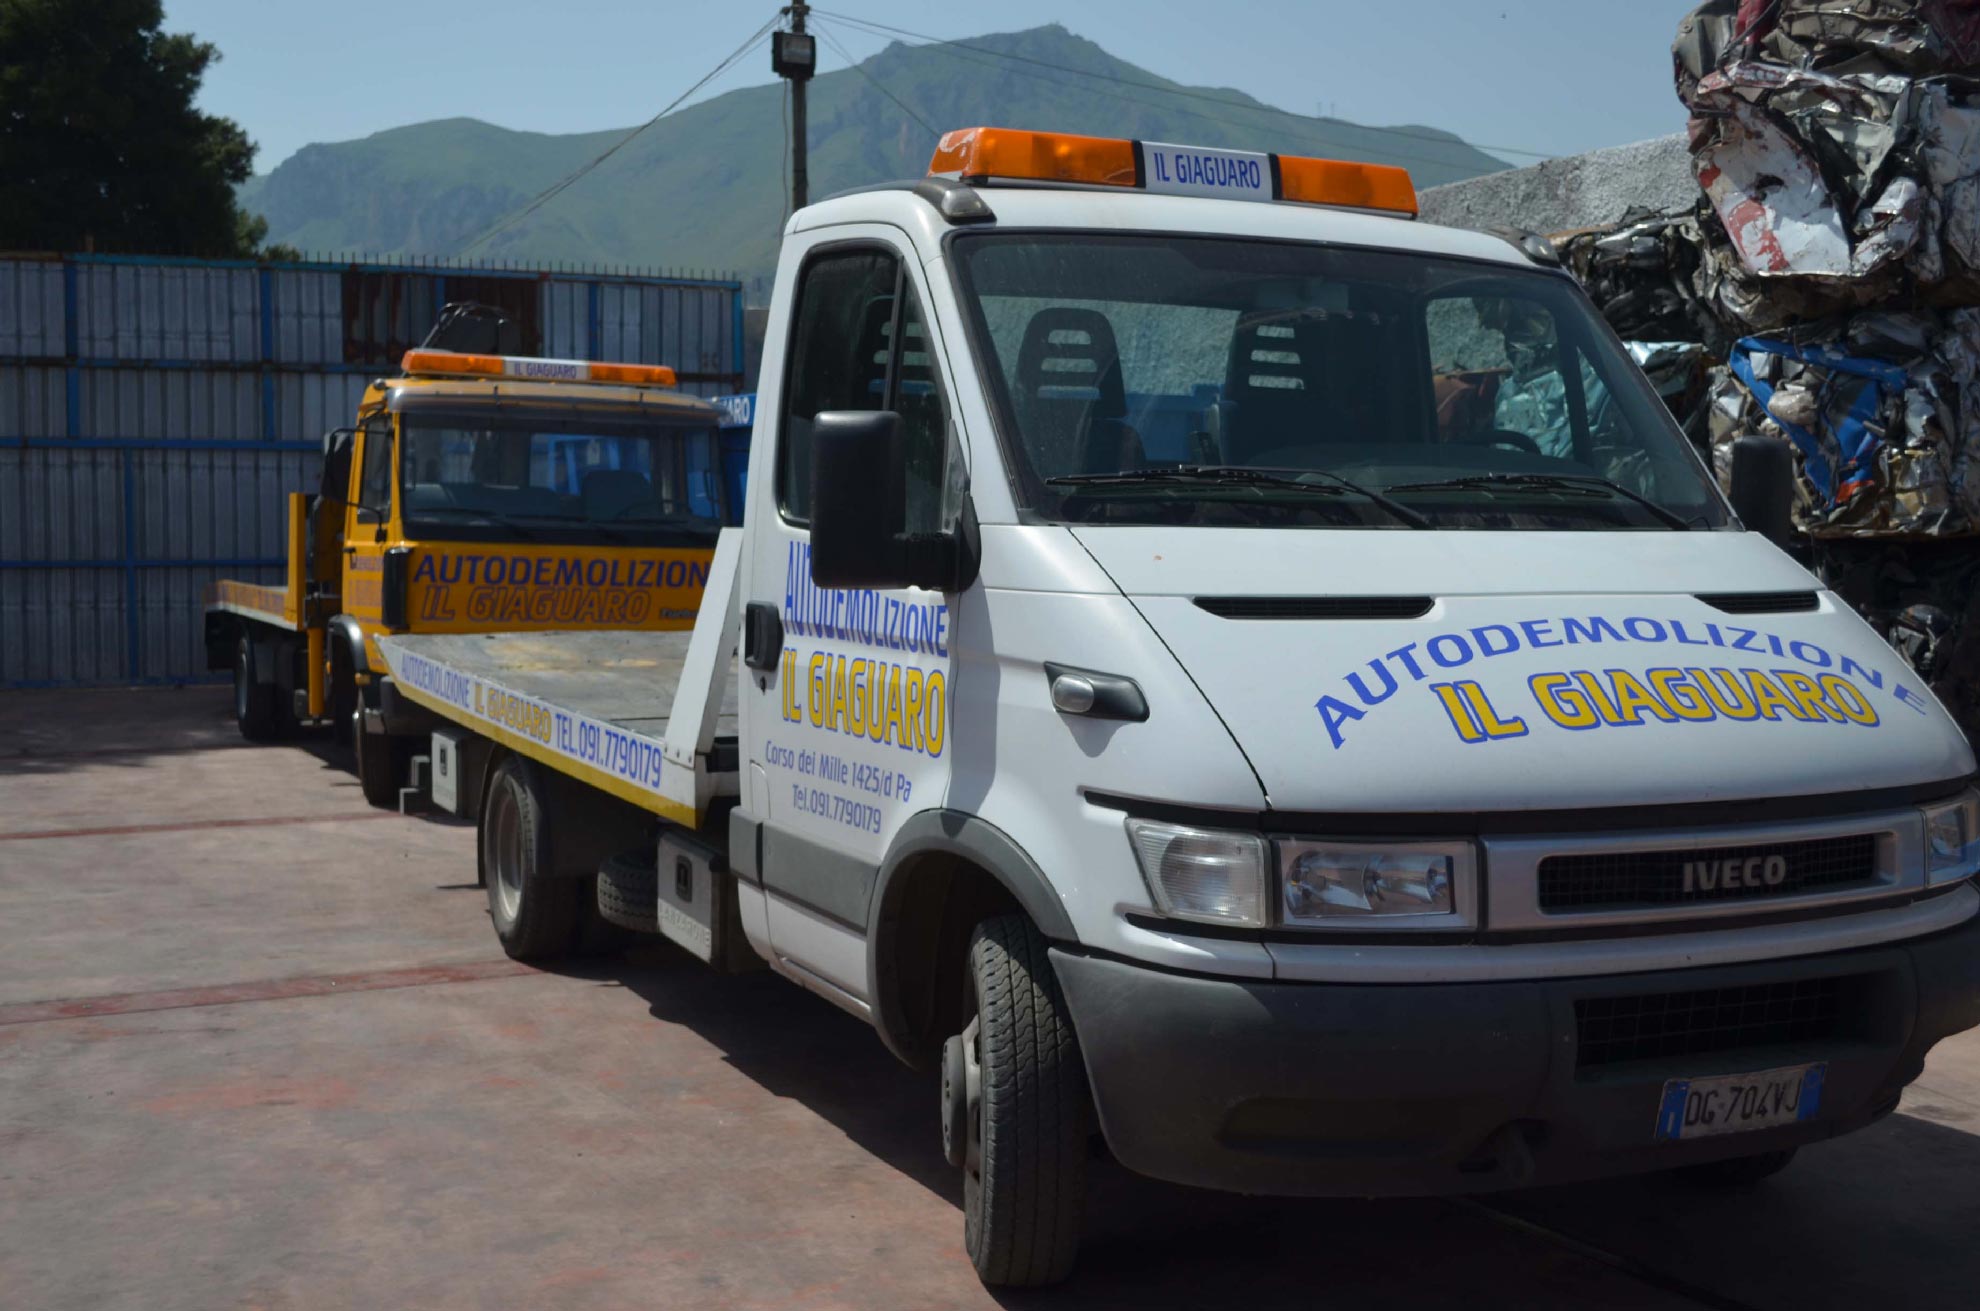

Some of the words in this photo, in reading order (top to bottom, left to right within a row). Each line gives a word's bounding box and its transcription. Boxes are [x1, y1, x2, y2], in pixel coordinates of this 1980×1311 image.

[1154, 153, 1170, 182] IL
[1175, 154, 1261, 189] GIAGUARO
[514, 362, 522, 376] IL
[527, 363, 577, 379] GIAGUARO
[413, 555, 711, 588] AUTODEMOLIZION
[784, 540, 948, 658] AUTODEMOLIZIONE
[421, 585, 455, 622] IL
[467, 586, 651, 624] GIAGUARO
[402, 653, 470, 709] AUTODEMOLIZIONE
[474, 681, 484, 713] IL
[487, 688, 552, 744] GIAGUARO
[782, 647, 801, 723] IL
[808, 650, 946, 758] GIAGUARO
[1314, 615, 1927, 749] AUTODEMOLIZIONE
[1430, 679, 1529, 744] IL
[1528, 667, 1880, 730] GIAGUARO
[765, 740, 795, 770] Corso
[798, 749, 816, 775] dei
[819, 753, 848, 785] Mille
[852, 762, 893, 797] 1425/d
[896, 773, 912, 802] Pa
[1683, 855, 1786, 892] IVECO
